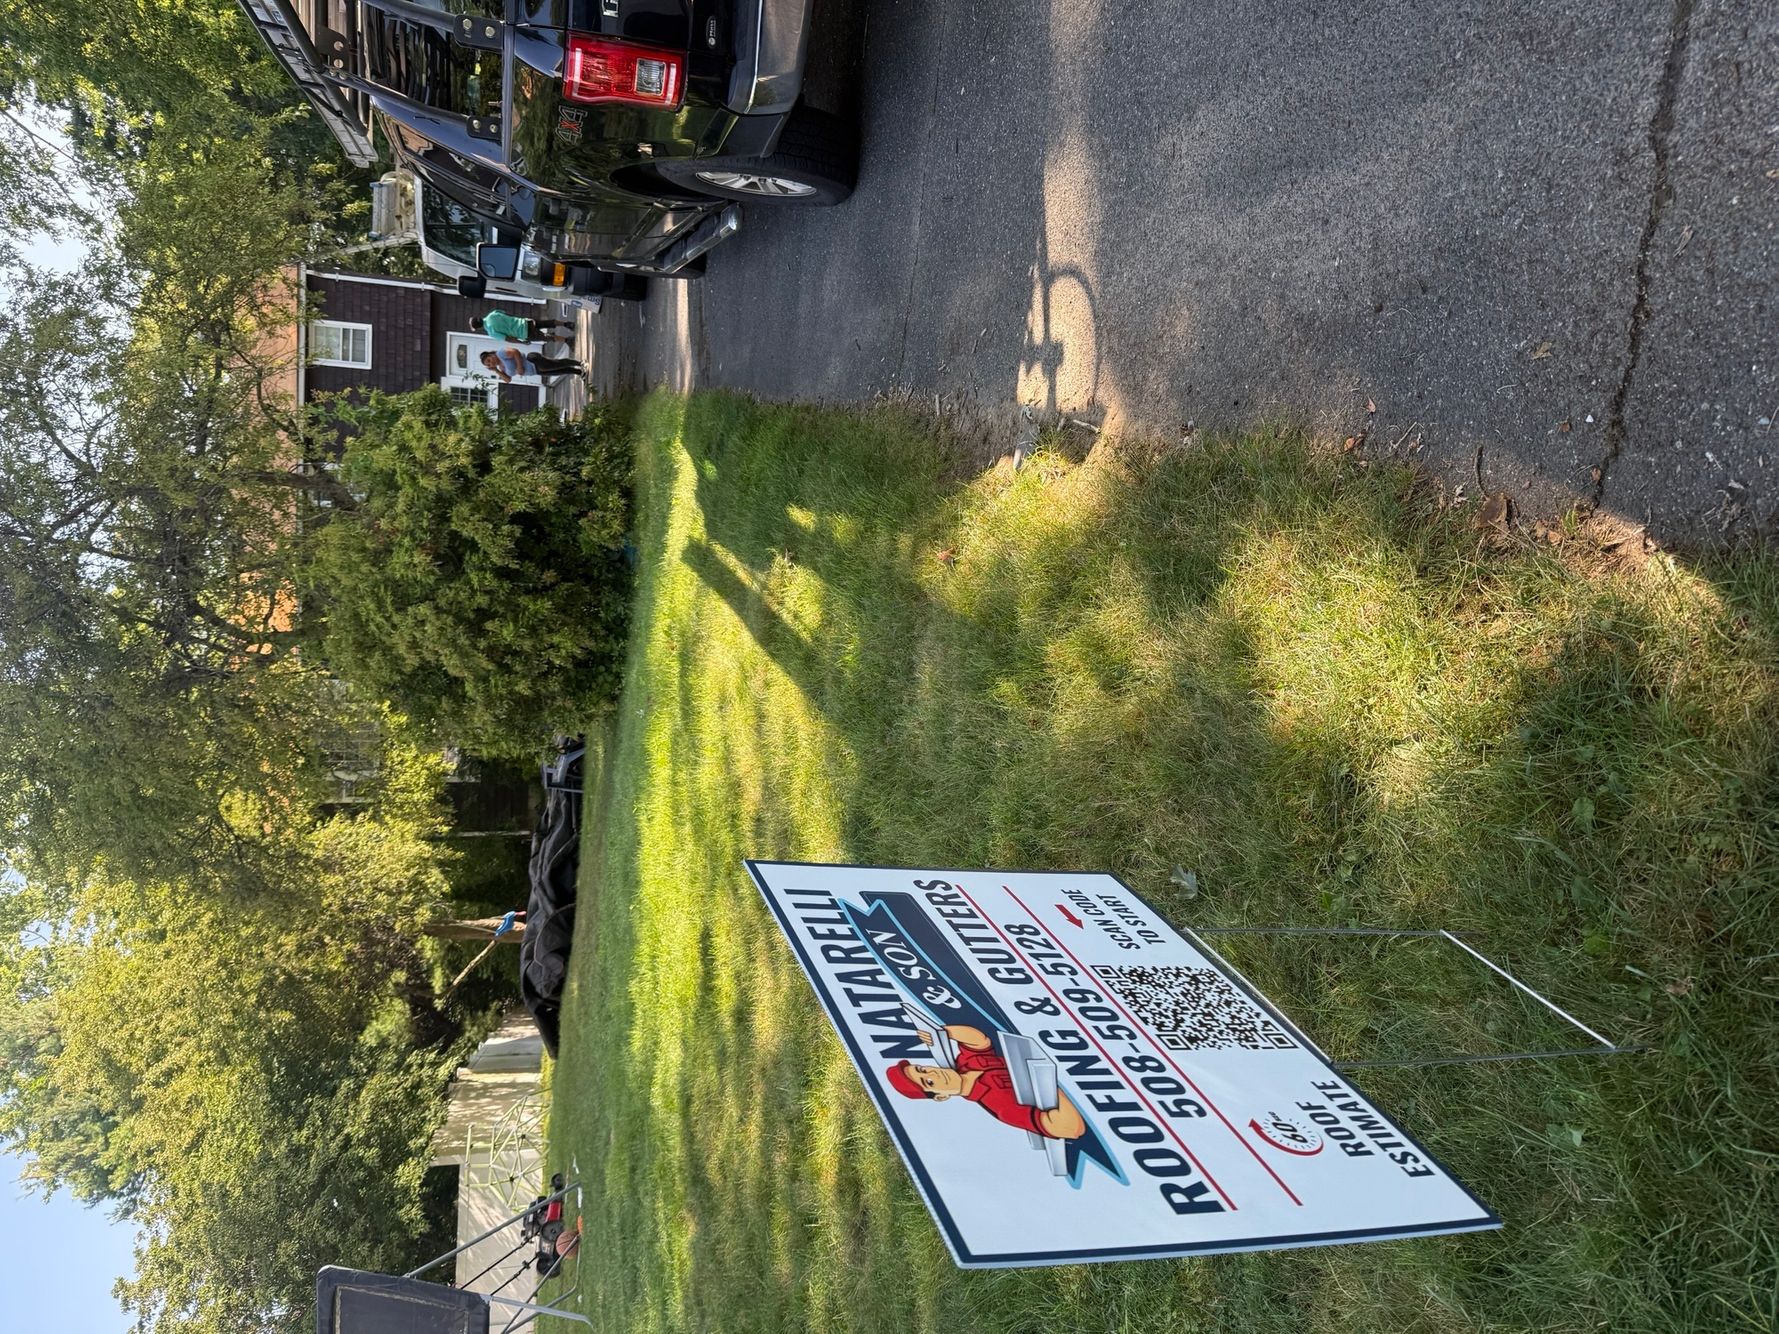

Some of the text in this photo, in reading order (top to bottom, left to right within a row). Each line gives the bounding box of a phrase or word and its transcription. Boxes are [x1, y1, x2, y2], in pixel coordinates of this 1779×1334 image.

[1061, 889, 1141, 949] SCAN CODE
[1096, 894, 1167, 945] TO START
[784, 888, 935, 1059] NATARELLI
[865, 928, 962, 1009] & SON
[913, 879, 1226, 1215] ROOFING & GUTTERS
[1005, 923, 1208, 1118] 508-509-5128
[1272, 1122, 1308, 1144] 60
[1295, 1101, 1375, 1157] ROOF
[1310, 1080, 1436, 1177] ESTIMATE
